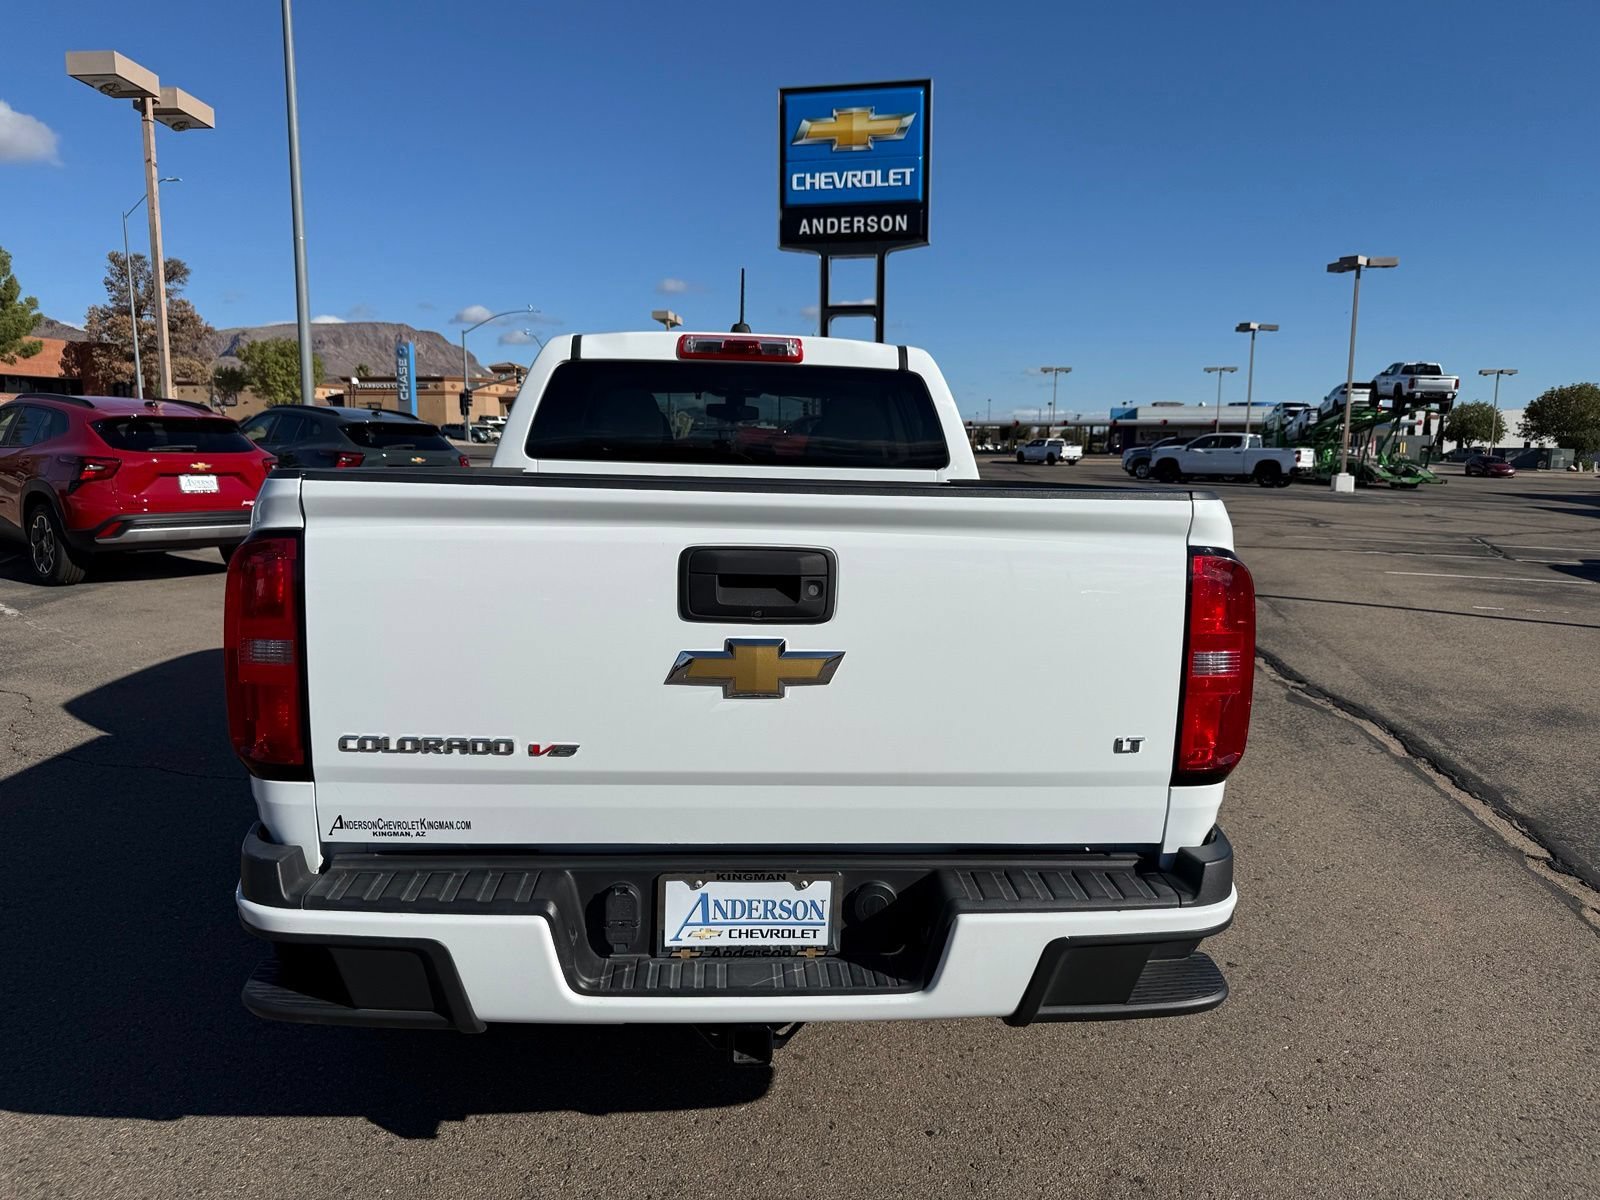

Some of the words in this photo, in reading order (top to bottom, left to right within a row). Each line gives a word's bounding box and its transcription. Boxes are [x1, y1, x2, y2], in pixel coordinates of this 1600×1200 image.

[791, 167, 915, 191] CHEVROLET
[798, 214, 909, 236] ANDERSON
[398, 358, 409, 401] CHASE
[338, 734, 515, 756] COLORADO
[527, 743, 580, 758] V6
[1112, 737, 1146, 754] LT
[716, 873, 787, 881] KINGMAN
[669, 892, 827, 942] ANDERSON
[728, 928, 820, 939] CHEVROLET
